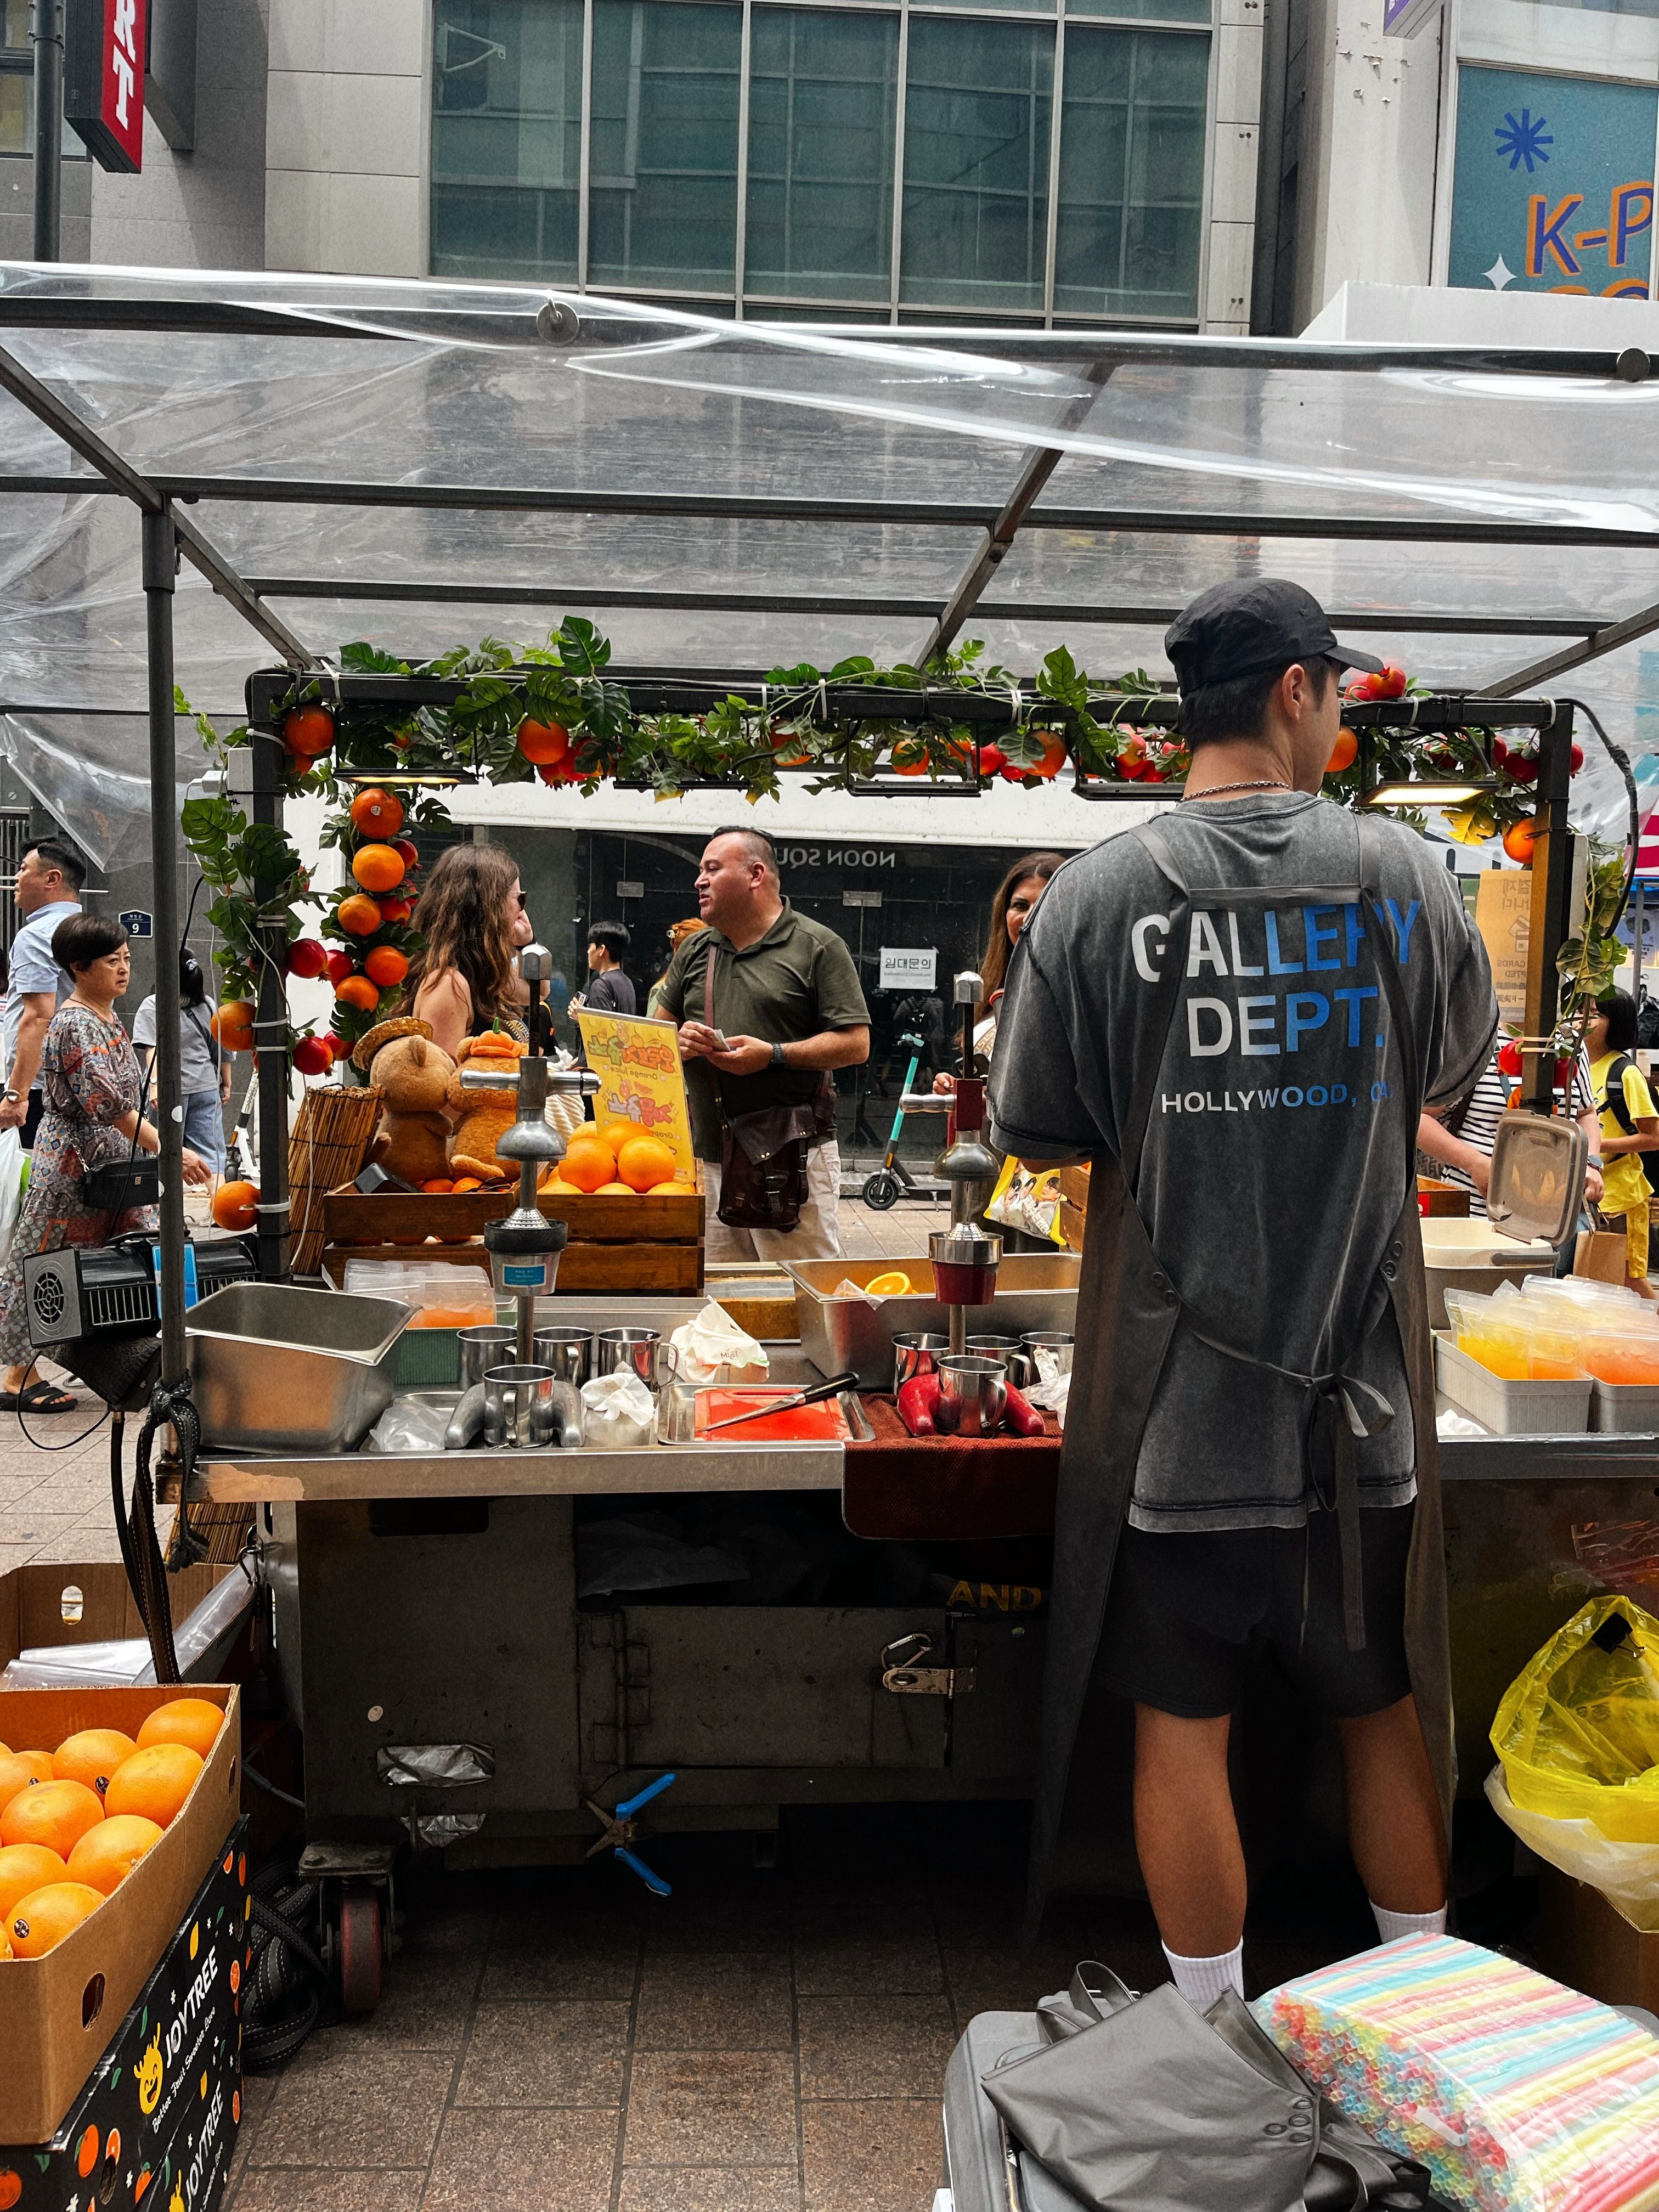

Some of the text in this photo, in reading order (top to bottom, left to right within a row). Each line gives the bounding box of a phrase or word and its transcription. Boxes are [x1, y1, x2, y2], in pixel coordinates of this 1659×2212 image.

[1526, 180, 1654, 278] K-P
[132, 923, 139, 934] 9
[885, 958, 931, 969] 임대문의
[1187, 985, 1384, 1057] DEPT.
[1161, 1084, 1357, 1113] HOLLYWOOD,
[945, 1580, 1042, 1612] AND
[166, 1944, 218, 2069] JOYTREE
[152, 2006, 216, 2134] Better Fruit Sweeter Love
[185, 2080, 223, 2212] JOYTREE
